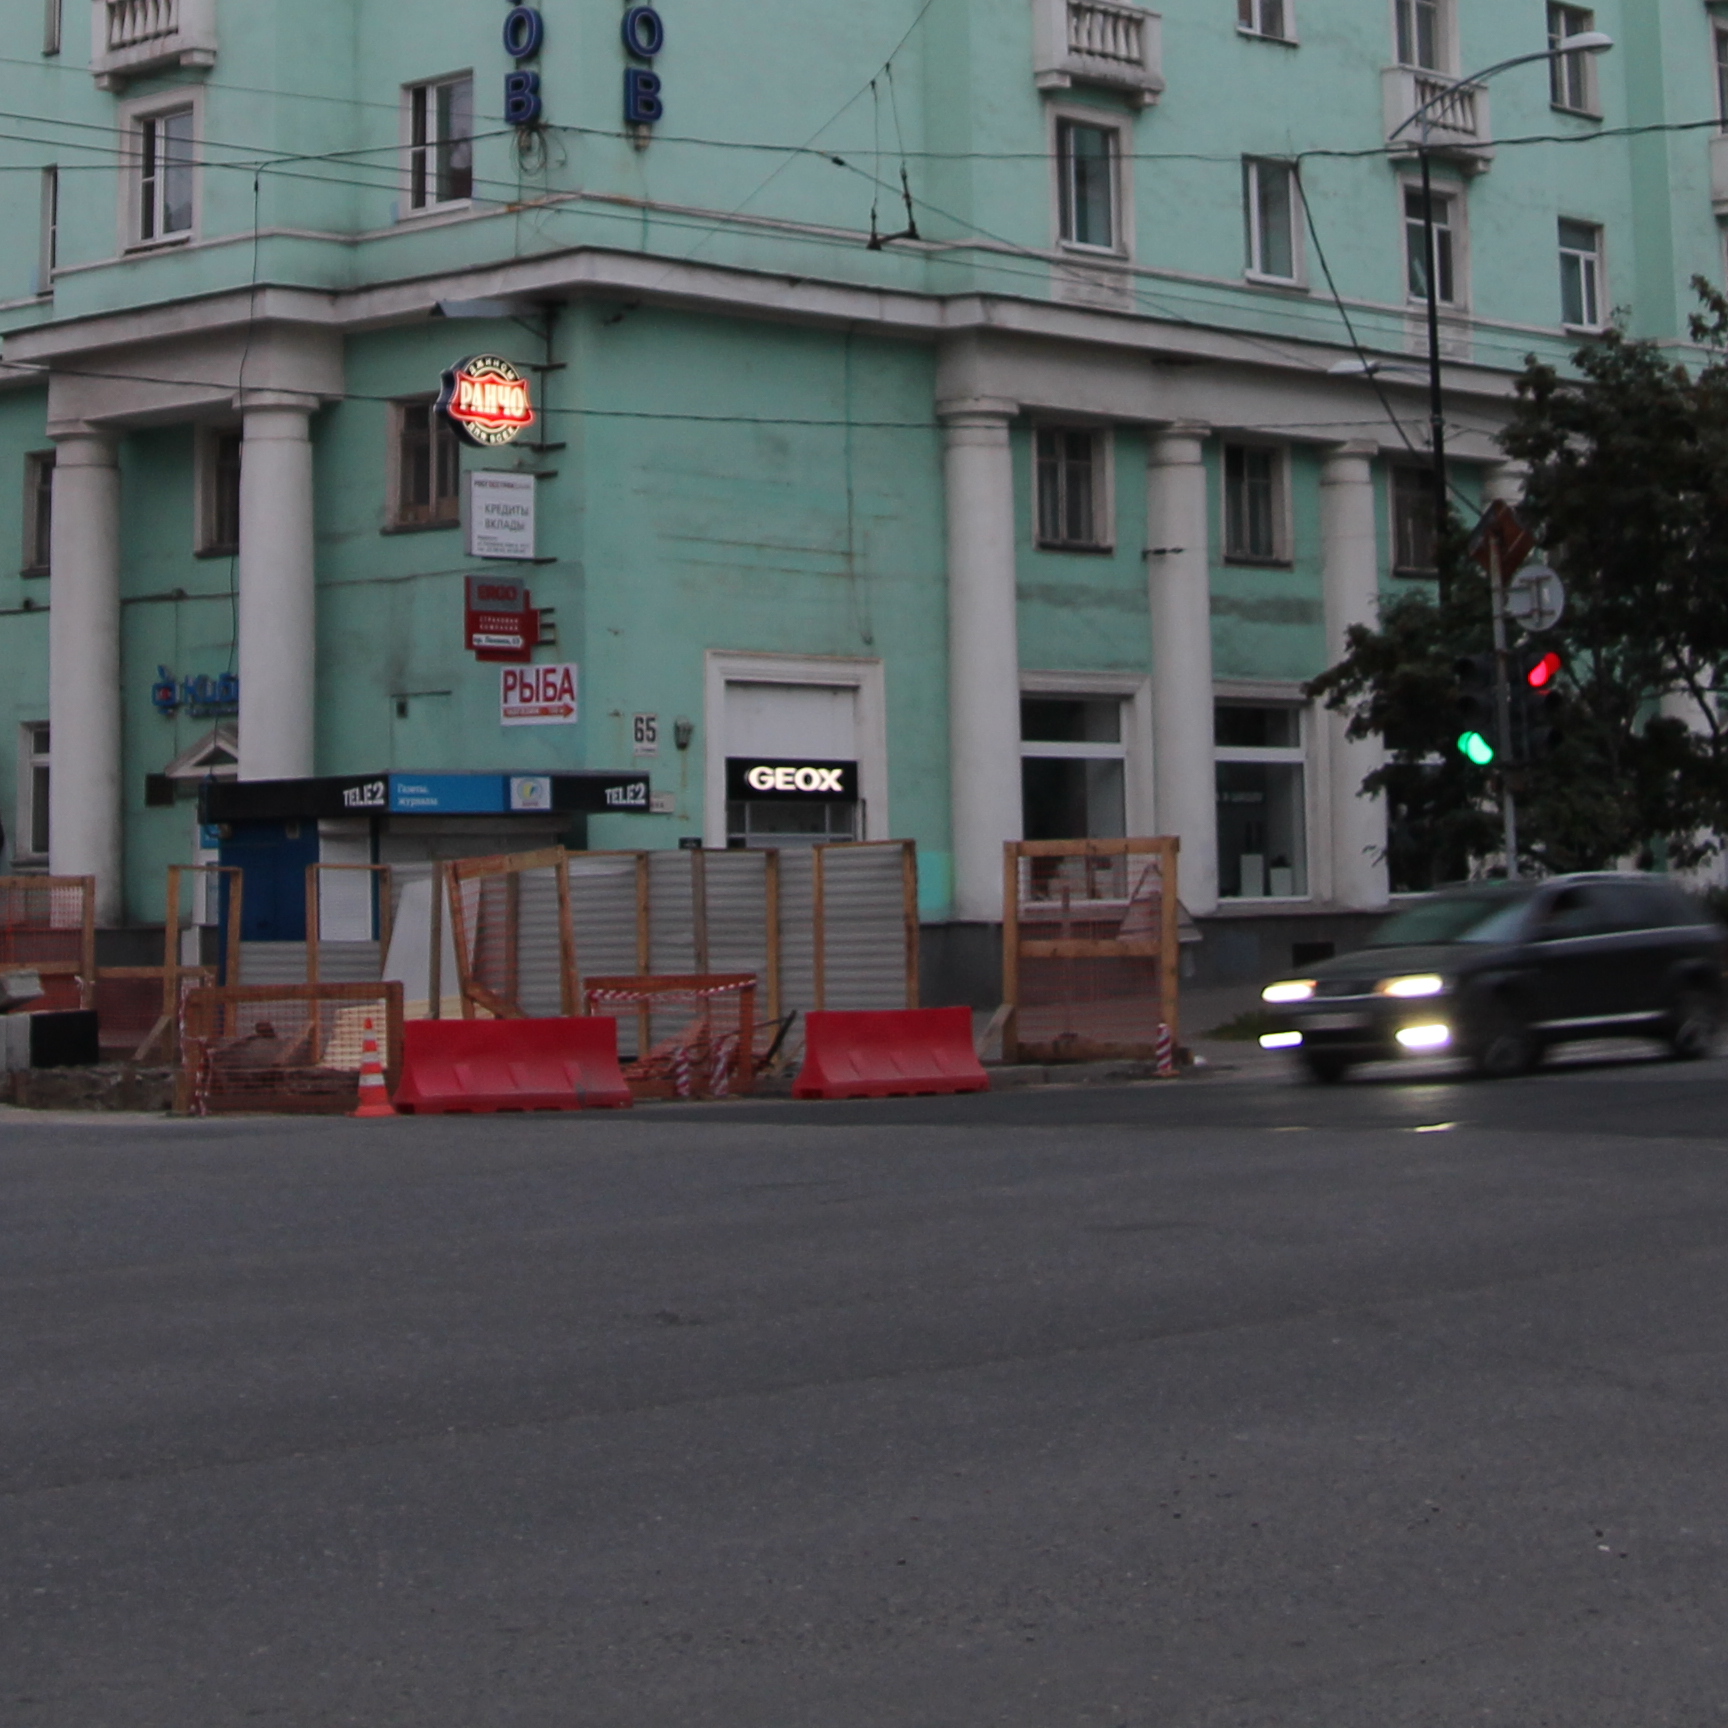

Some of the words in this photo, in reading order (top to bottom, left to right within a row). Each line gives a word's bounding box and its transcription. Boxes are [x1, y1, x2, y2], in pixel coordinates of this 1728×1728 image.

[460, 380, 525, 417] РАНЧО
[485, 503, 529, 517] КРЕДИТЫ
[485, 518, 526, 532] ВКЛАДЫ
[503, 667, 574, 703] РЫБА
[634, 717, 656, 743] 65
[747, 766, 843, 792] GEOX
[342, 781, 385, 806] TELE2
[604, 782, 647, 805] TELE2
